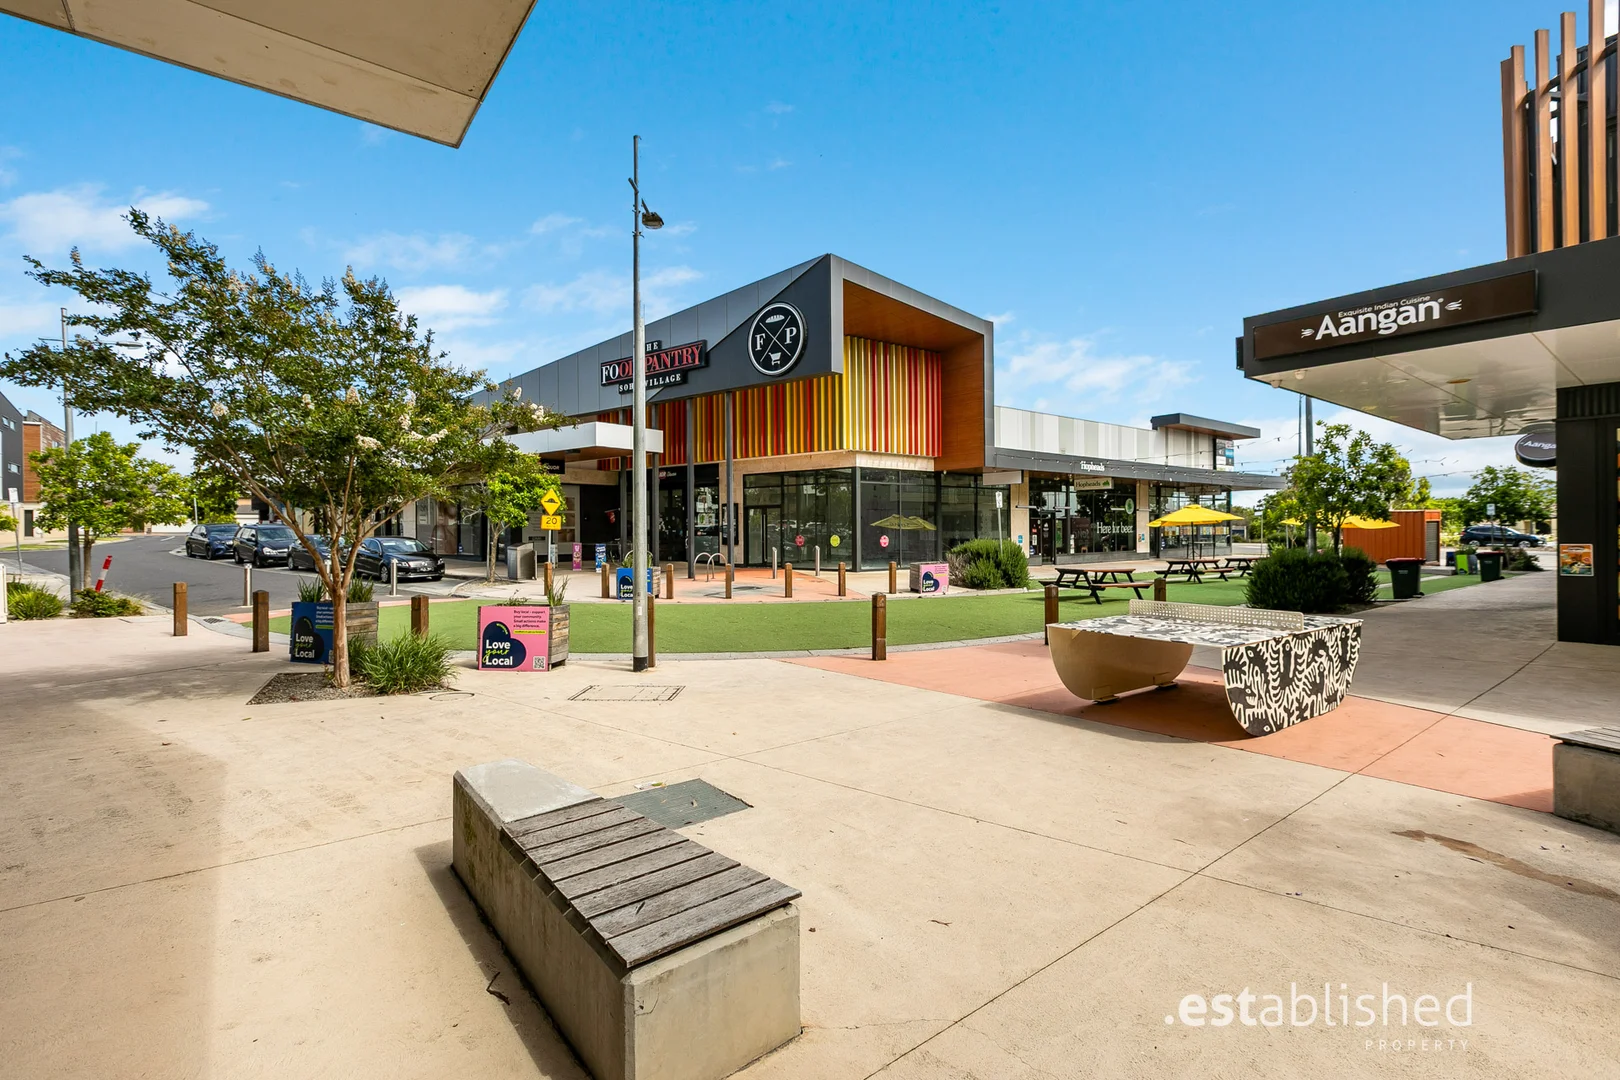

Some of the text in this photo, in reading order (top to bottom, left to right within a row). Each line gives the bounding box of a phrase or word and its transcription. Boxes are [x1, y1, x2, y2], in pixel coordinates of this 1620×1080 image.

[1338, 295, 1431, 318] Exquisite Indian Cuisine
[1315, 300, 1441, 341] Aangan
[784, 326, 797, 345] P
[646, 342, 659, 352] HE
[755, 333, 766, 351] F
[619, 383, 634, 392] SOH
[1523, 440, 1557, 450] Aanga
[1075, 480, 1101, 488] Hopheads
[546, 517, 558, 525] 20
[1096, 521, 1112, 534] Here
[1112, 521, 1121, 534] for
[295, 633, 314, 643] Love
[486, 640, 511, 649] Love
[295, 649, 315, 658] Local
[486, 656, 513, 666] Local
